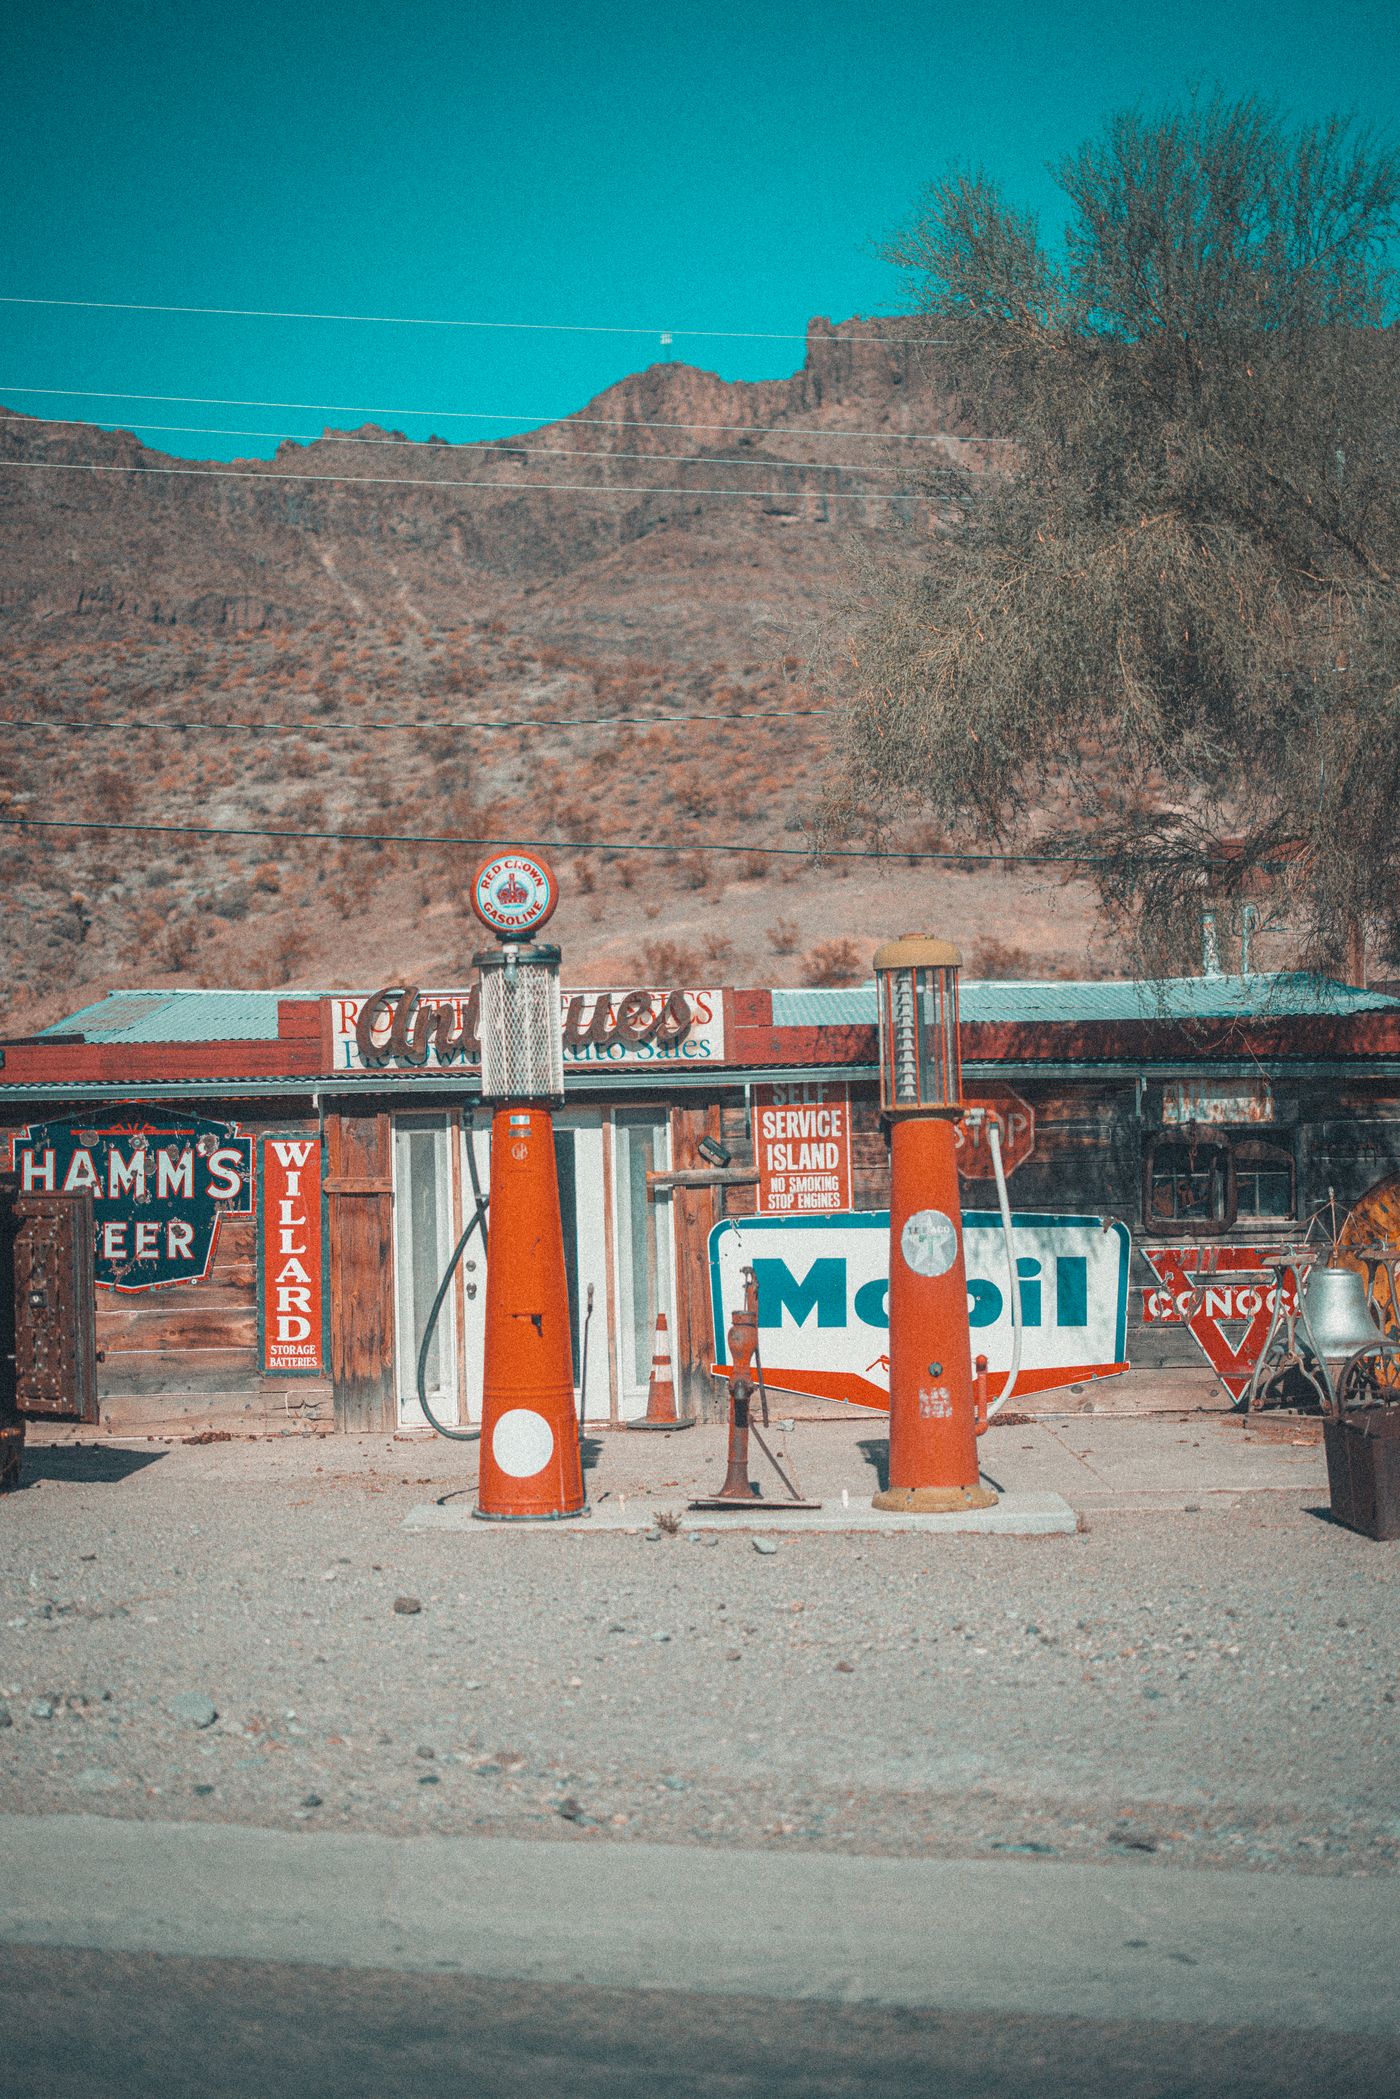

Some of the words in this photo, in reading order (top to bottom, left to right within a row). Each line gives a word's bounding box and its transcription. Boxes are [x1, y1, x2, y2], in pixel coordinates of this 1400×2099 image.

[481, 864, 502, 890] RED
[483, 901, 543, 926] GASOLINE
[356, 985, 691, 1058] Antues
[562, 1041, 626, 1062] uto
[762, 1110, 842, 1139] SERVICE
[766, 1143, 839, 1172] ISLAND
[770, 1177, 786, 1193] NO
[789, 1176, 839, 1193] SMOKING
[768, 1194, 794, 1210] STOP
[797, 1192, 841, 1209] ENGINES
[103, 1221, 195, 1260] EER
[271, 1142, 315, 1342] WILLARD
[270, 1344, 316, 1355] STORAGE
[270, 1356, 318, 1367] BATTERIES
